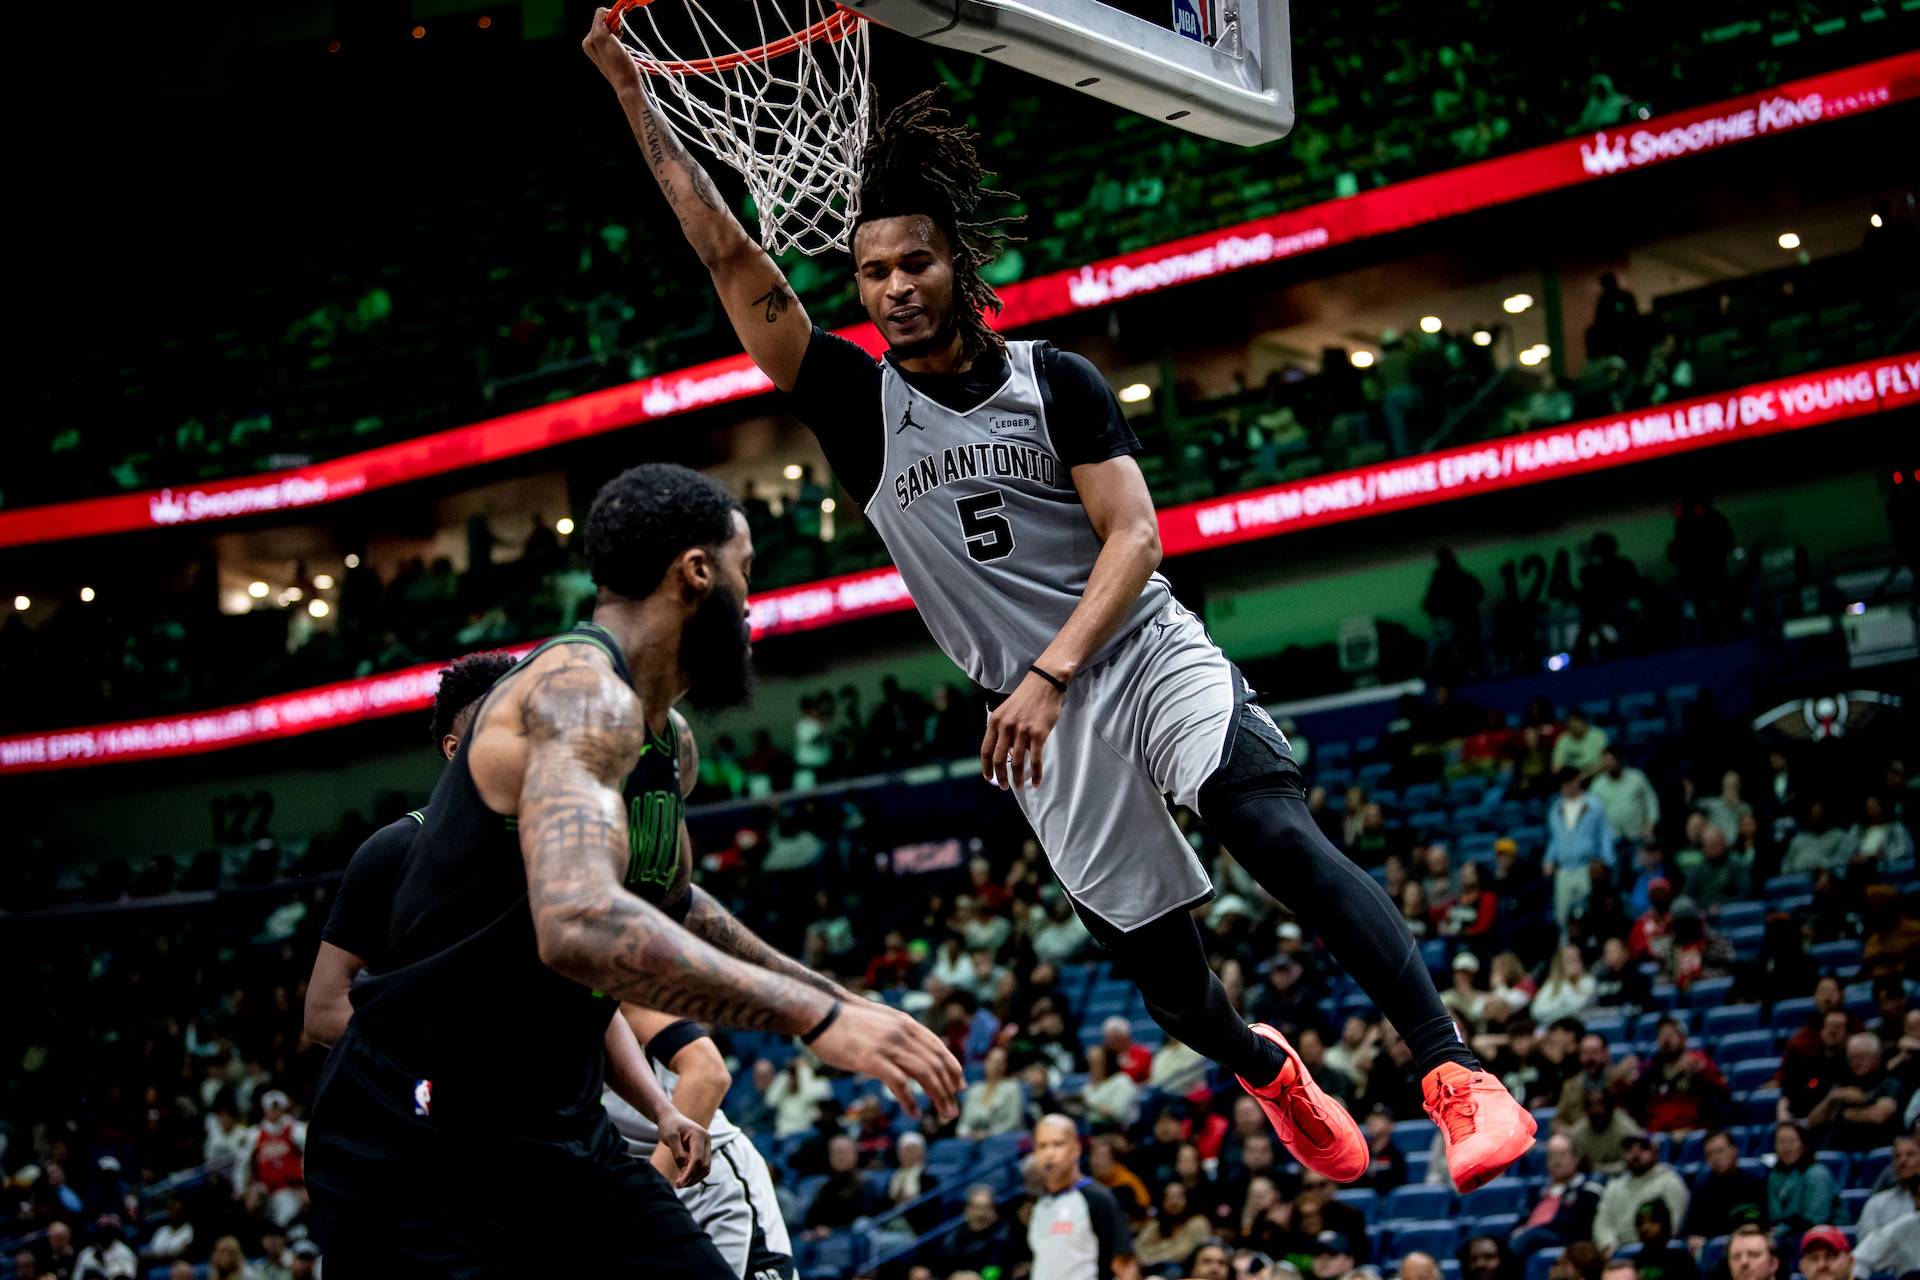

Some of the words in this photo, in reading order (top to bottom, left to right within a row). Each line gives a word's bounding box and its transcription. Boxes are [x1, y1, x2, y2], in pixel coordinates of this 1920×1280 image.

[1178, 8, 1197, 35] NBA
[1629, 109, 1756, 164] SMOOTHIE
[1110, 247, 1215, 298] SMOOTHIE
[995, 419, 1030, 429] LEDGER
[894, 454, 940, 512] SAN
[943, 443, 1056, 488] ANTONIO
[1196, 502, 1237, 537] WE
[1236, 489, 1302, 528] THEM
[1302, 475, 1366, 517] ONES
[1377, 461, 1438, 500] MIKE
[1438, 448, 1502, 489] EPPS
[1513, 421, 1630, 472] KARLOUS
[1629, 402, 1725, 448] MILLER
[1738, 391, 1779, 426] DC
[1778, 371, 1873, 416] YOUNG
[954, 489, 1016, 564] 5
[0, 737, 46, 766] MIKE
[47, 731, 97, 761] EPPS
